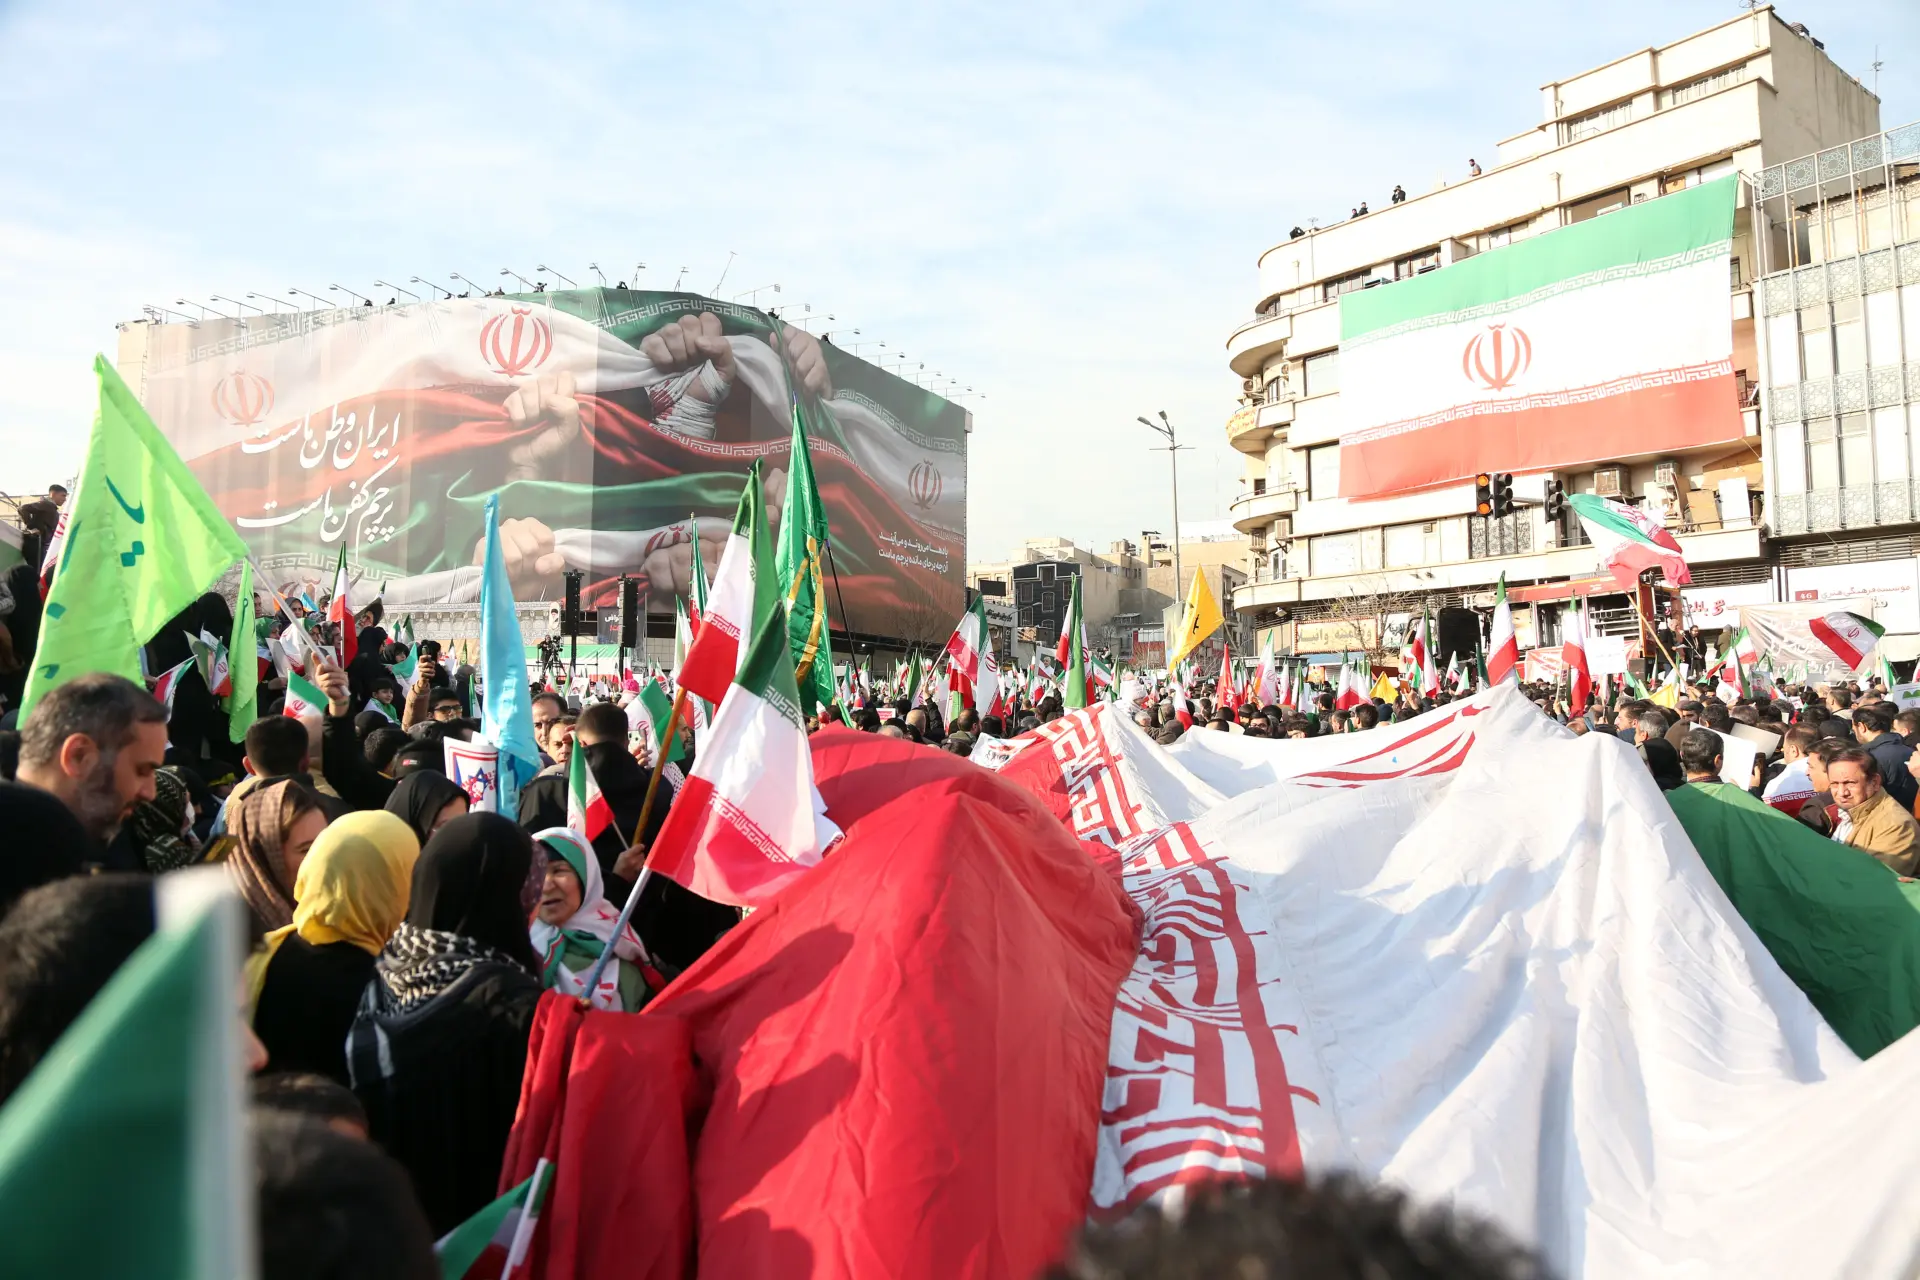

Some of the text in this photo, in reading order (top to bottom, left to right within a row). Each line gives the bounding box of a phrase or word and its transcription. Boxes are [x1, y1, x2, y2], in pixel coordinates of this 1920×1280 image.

[241, 403, 400, 470] ایران وطن ماست
[236, 454, 400, 562] پرچم کفن ماست
[1843, 586, 1877, 597] فرهنگی
